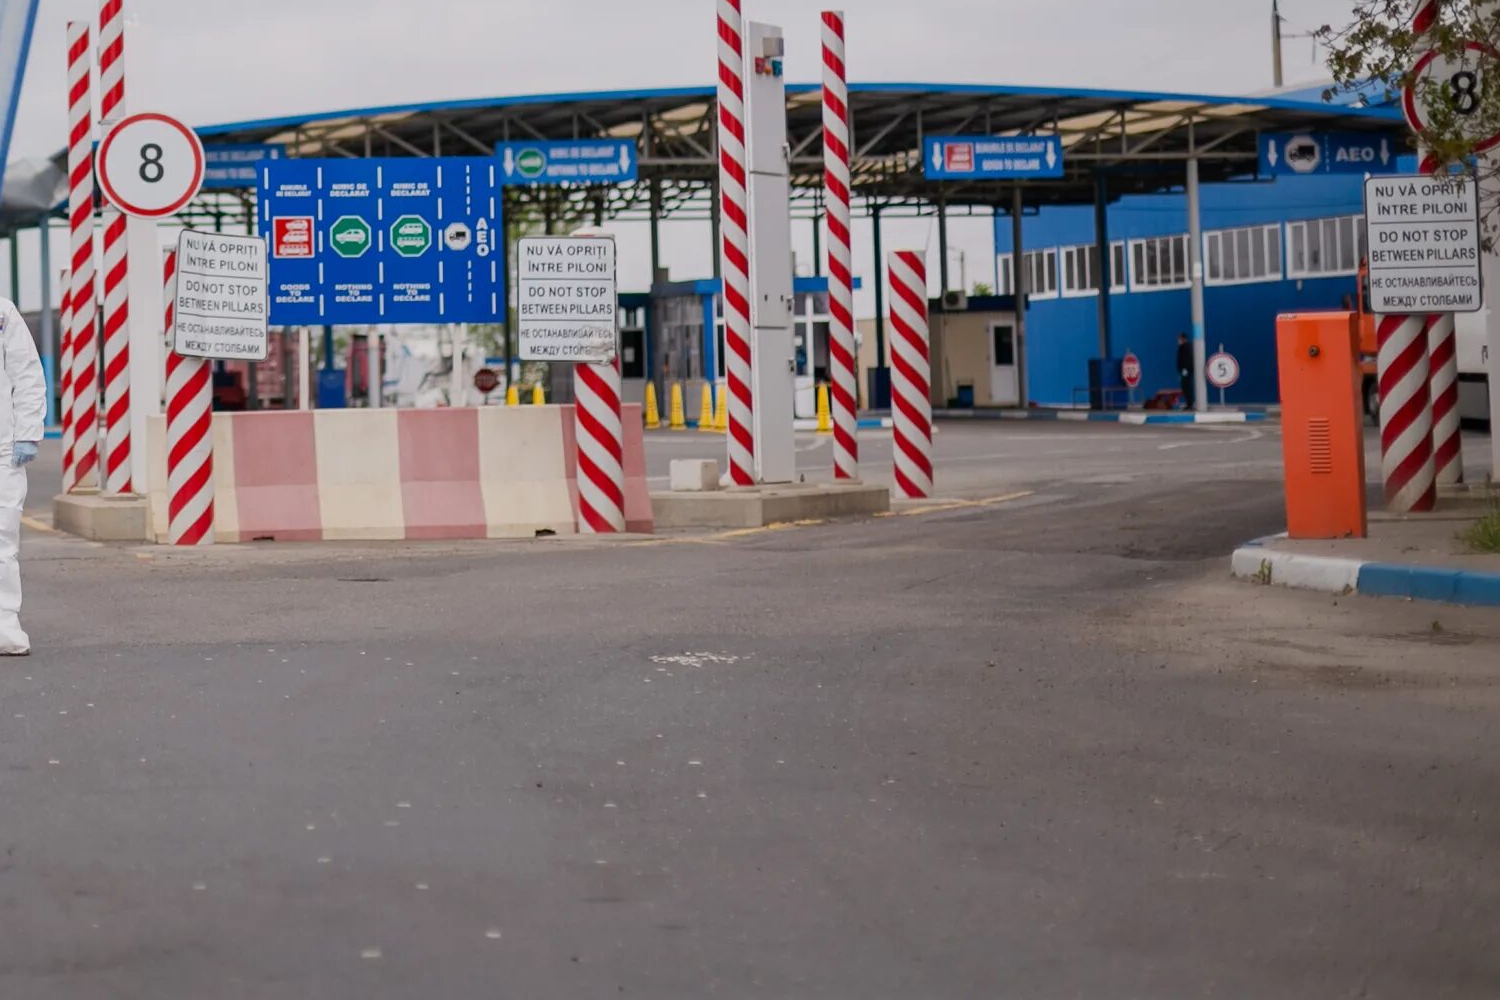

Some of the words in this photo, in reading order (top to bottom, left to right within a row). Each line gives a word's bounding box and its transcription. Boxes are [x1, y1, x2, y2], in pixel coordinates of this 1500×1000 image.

[1451, 71, 1478, 115] 8
[1335, 147, 1375, 162] AEO
[139, 143, 164, 183] 8
[1375, 186, 1394, 197] NU
[1399, 183, 1417, 196] VĂ
[1377, 203, 1418, 215] ÎNTRE
[1422, 202, 1467, 214] PILONI
[476, 217, 489, 257] AEO
[1380, 231, 1398, 243] DO
[1402, 230, 1429, 242] NOT
[1433, 229, 1468, 241] STOP
[186, 239, 200, 249] NU
[527, 246, 543, 256] NU
[547, 245, 563, 256] VĂ
[1372, 249, 1424, 262] BETWEEN
[1426, 247, 1476, 260] PILLARS
[186, 254, 216, 269] ÎNTRE
[220, 260, 258, 272] PILONI
[528, 261, 563, 272] ÎNTRE
[567, 263, 607, 272] PILONI
[186, 280, 200, 292] DO
[201, 282, 224, 294] NOT
[228, 284, 258, 296] STOP
[1372, 278, 1383, 288] НЕ
[1385, 275, 1477, 288] ОСТАНАВЛИВАЙТЕСЬ
[528, 287, 545, 297] DO
[549, 287, 572, 297] NOT
[576, 287, 607, 297] STOP
[179, 297, 219, 311] BETWEEN
[222, 300, 263, 313] PILLARS
[1383, 296, 1417, 308] МЕЖДУ
[1420, 294, 1473, 306] СТОЛБАМИ
[521, 304, 567, 314] BETWEEN
[569, 304, 612, 315] PILLARS
[178, 322, 186, 332] НЕ
[521, 329, 530, 338] НЕ
[185, 340, 212, 352] МЕЖДУ
[214, 342, 260, 353] СТОЛБАМИ
[530, 346, 560, 356] МЕЖДУ
[1218, 363, 1227, 378] 5
